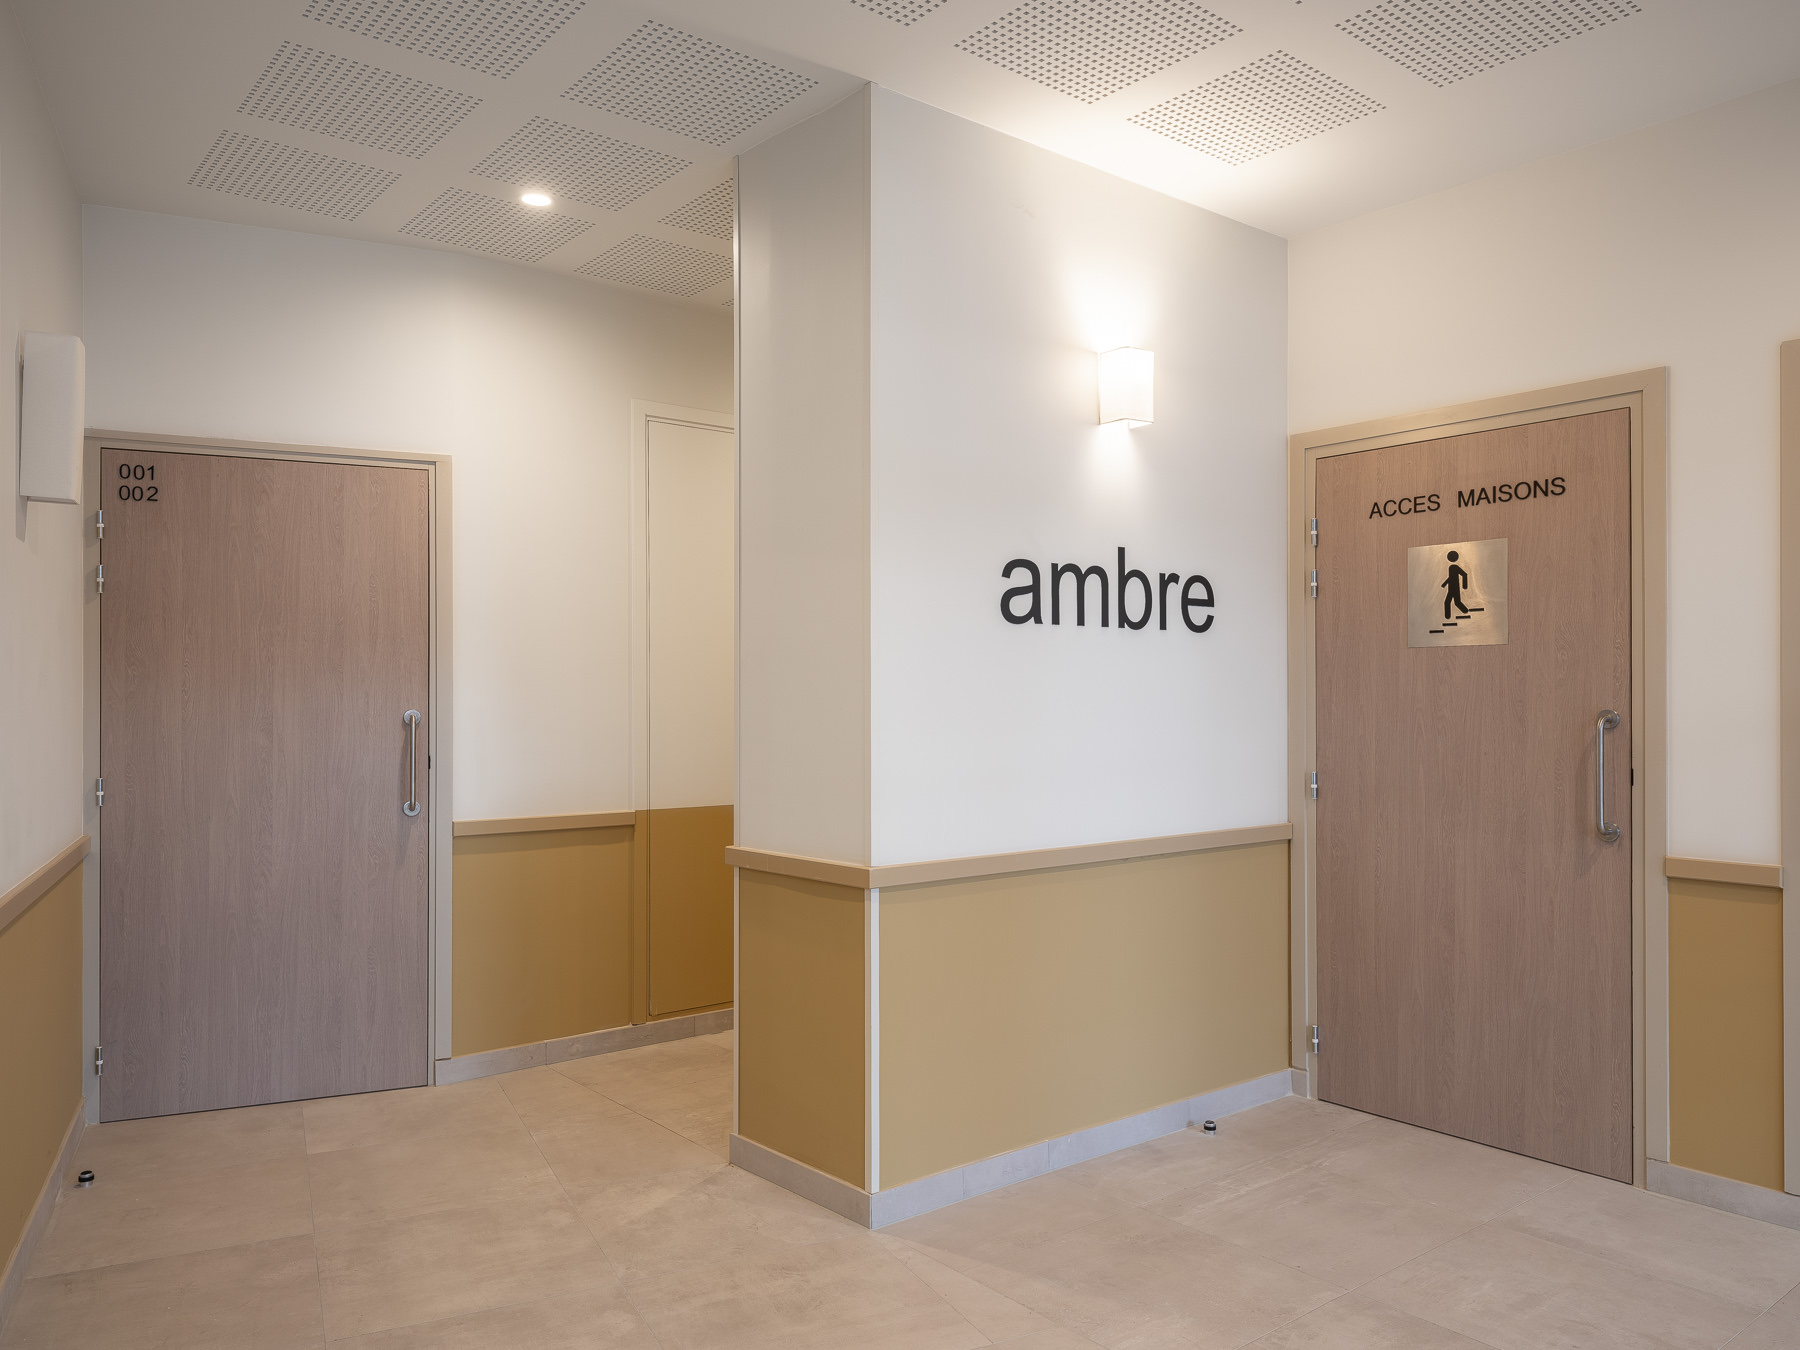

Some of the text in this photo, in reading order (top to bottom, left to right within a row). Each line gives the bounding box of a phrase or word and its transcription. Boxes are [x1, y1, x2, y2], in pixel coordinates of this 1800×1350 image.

[118, 463, 156, 482] 001
[117, 484, 159, 503] 002
[1368, 476, 1567, 520] ACCES MAISONS
[1000, 546, 1216, 634] ambre
